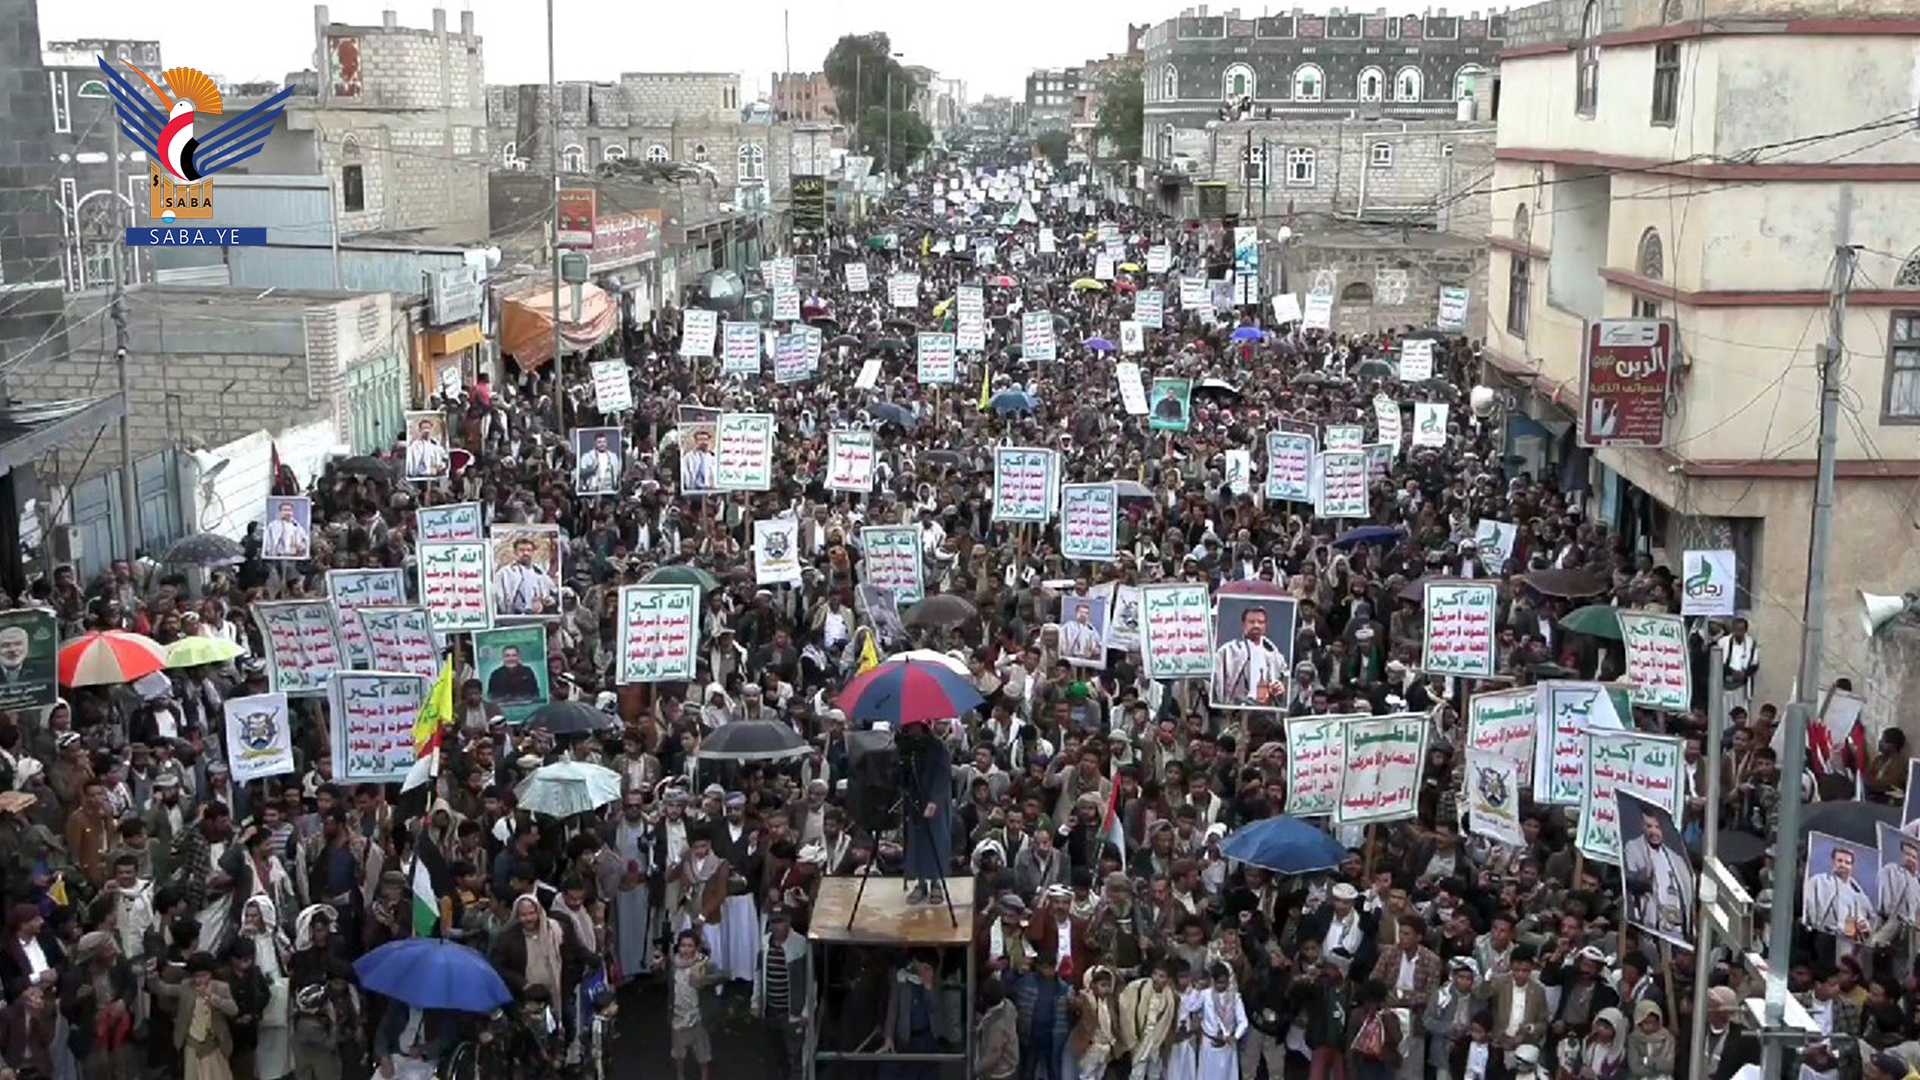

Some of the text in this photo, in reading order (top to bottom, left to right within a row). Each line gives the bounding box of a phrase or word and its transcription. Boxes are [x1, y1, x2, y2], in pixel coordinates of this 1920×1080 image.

[1616, 347, 1665, 380] الزين
[668, 594, 690, 608] الله
[1468, 591, 1490, 605] الله
[391, 681, 418, 695] الله
[1643, 747, 1674, 767] الله
